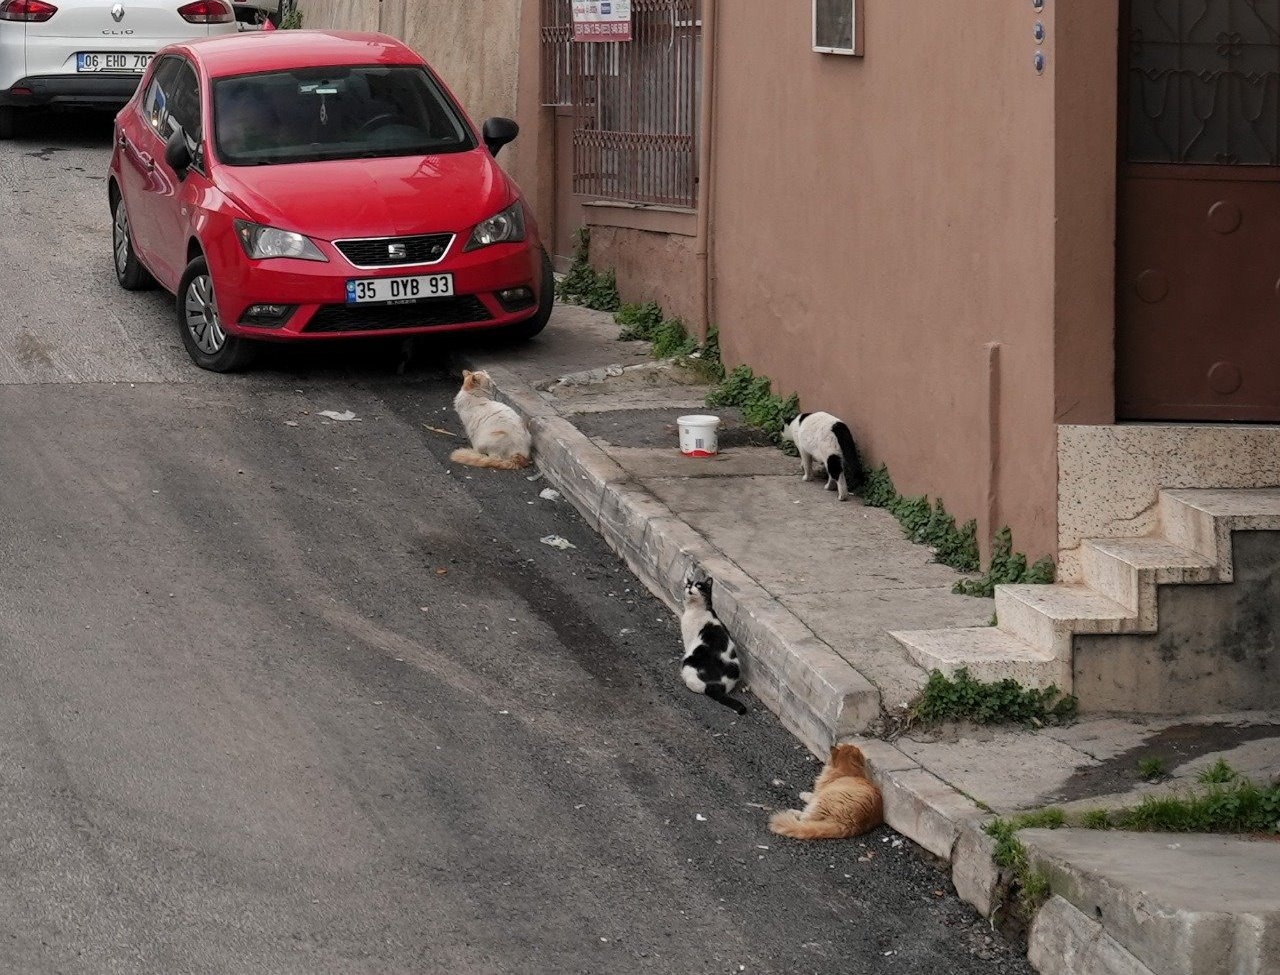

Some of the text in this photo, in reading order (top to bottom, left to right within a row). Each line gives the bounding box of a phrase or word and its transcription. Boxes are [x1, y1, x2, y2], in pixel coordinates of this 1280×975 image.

[102, 28, 135, 36] CLIO
[85, 54, 99, 67] 06
[133, 54, 154, 67] 70
[356, 276, 449, 299] 35 DYB 93
